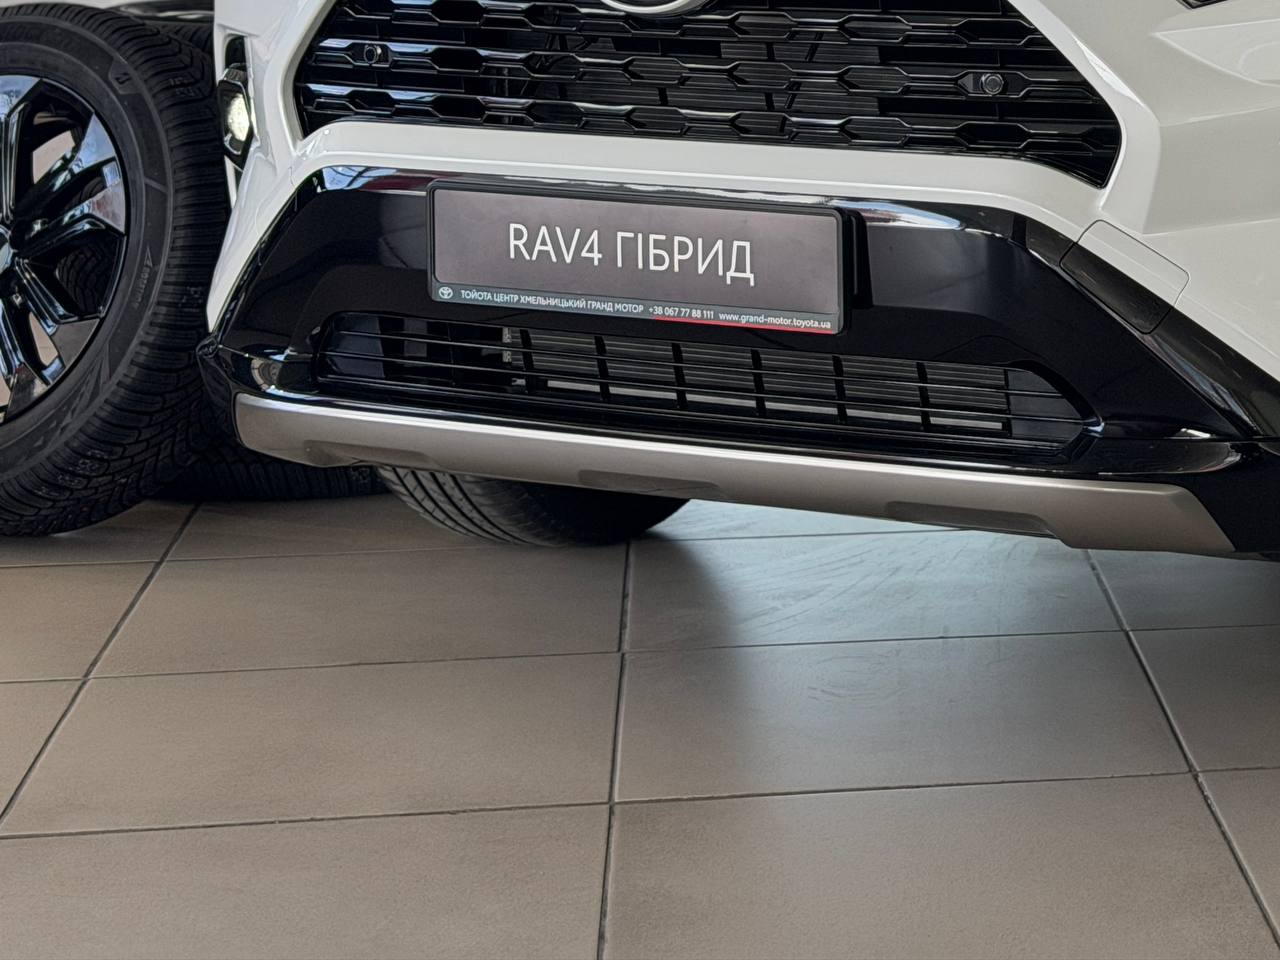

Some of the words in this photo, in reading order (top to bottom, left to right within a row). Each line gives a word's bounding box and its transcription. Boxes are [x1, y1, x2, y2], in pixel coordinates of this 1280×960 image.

[508, 223, 603, 266] RAV4
[616, 230, 755, 287] ГІБРИД
[460, 289, 493, 301] ТОЙОТА
[493, 292, 519, 304] ЦЕНТР
[519, 294, 586, 309] ХМЕЛЬНИЦЬКИЙ
[587, 298, 613, 312] ГРАНД
[614, 302, 644, 314] МОТОР
[648, 305, 663, 316] +38
[664, 306, 679, 317] 067
[680, 308, 690, 318] 77
[691, 309, 702, 319] 88
[703, 310, 714, 320] 111
[718, 312, 831, 329] www.grand-motor.toyota.ua
